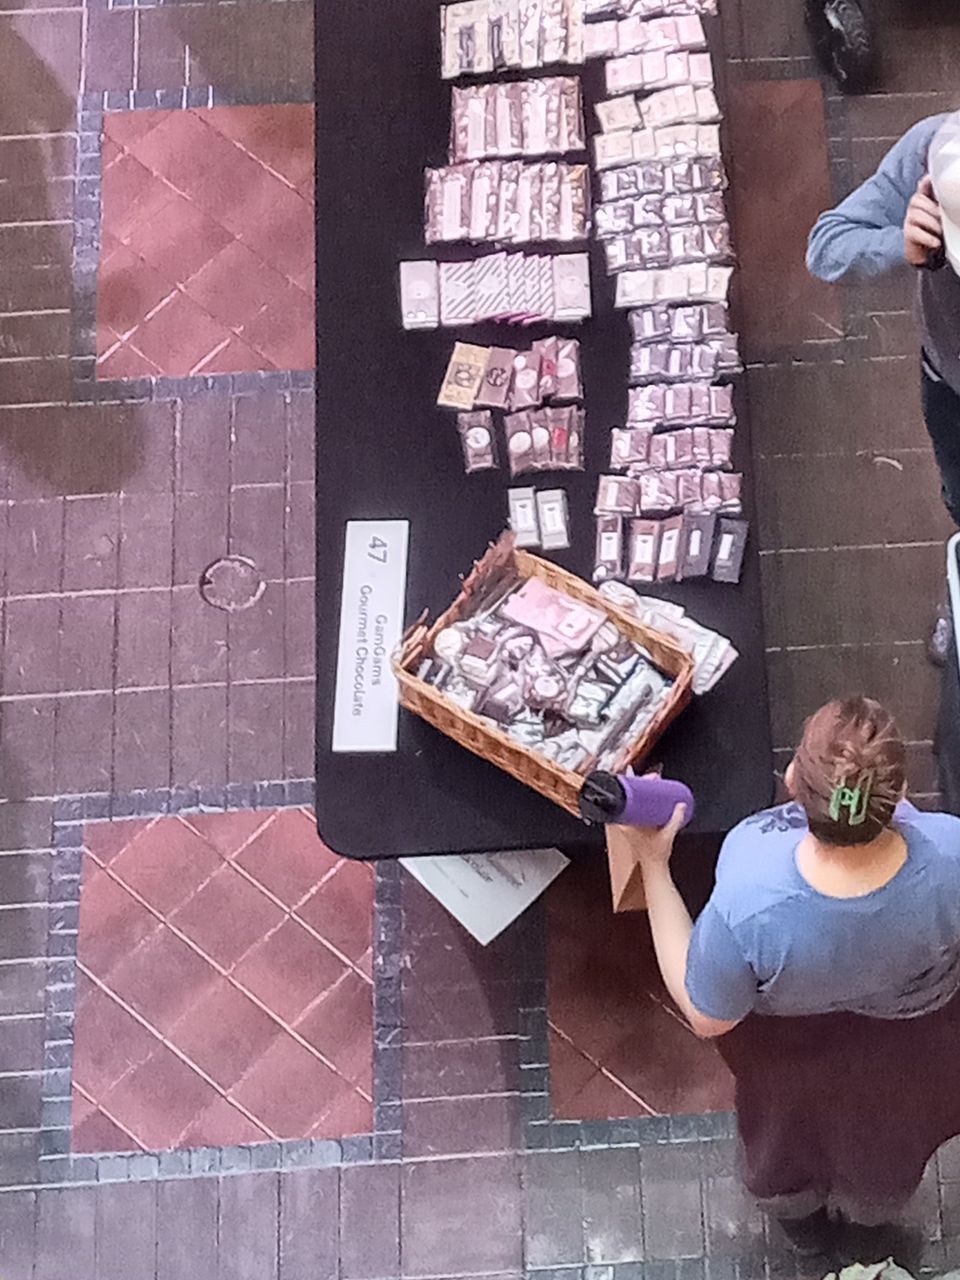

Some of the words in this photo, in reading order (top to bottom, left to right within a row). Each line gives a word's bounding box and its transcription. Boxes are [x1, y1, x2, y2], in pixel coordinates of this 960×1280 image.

[367, 535, 388, 564] 47
[359, 584, 373, 642] Gourmet
[353, 646, 369, 716] Chocolate
[371, 614, 388, 686] GamGams
